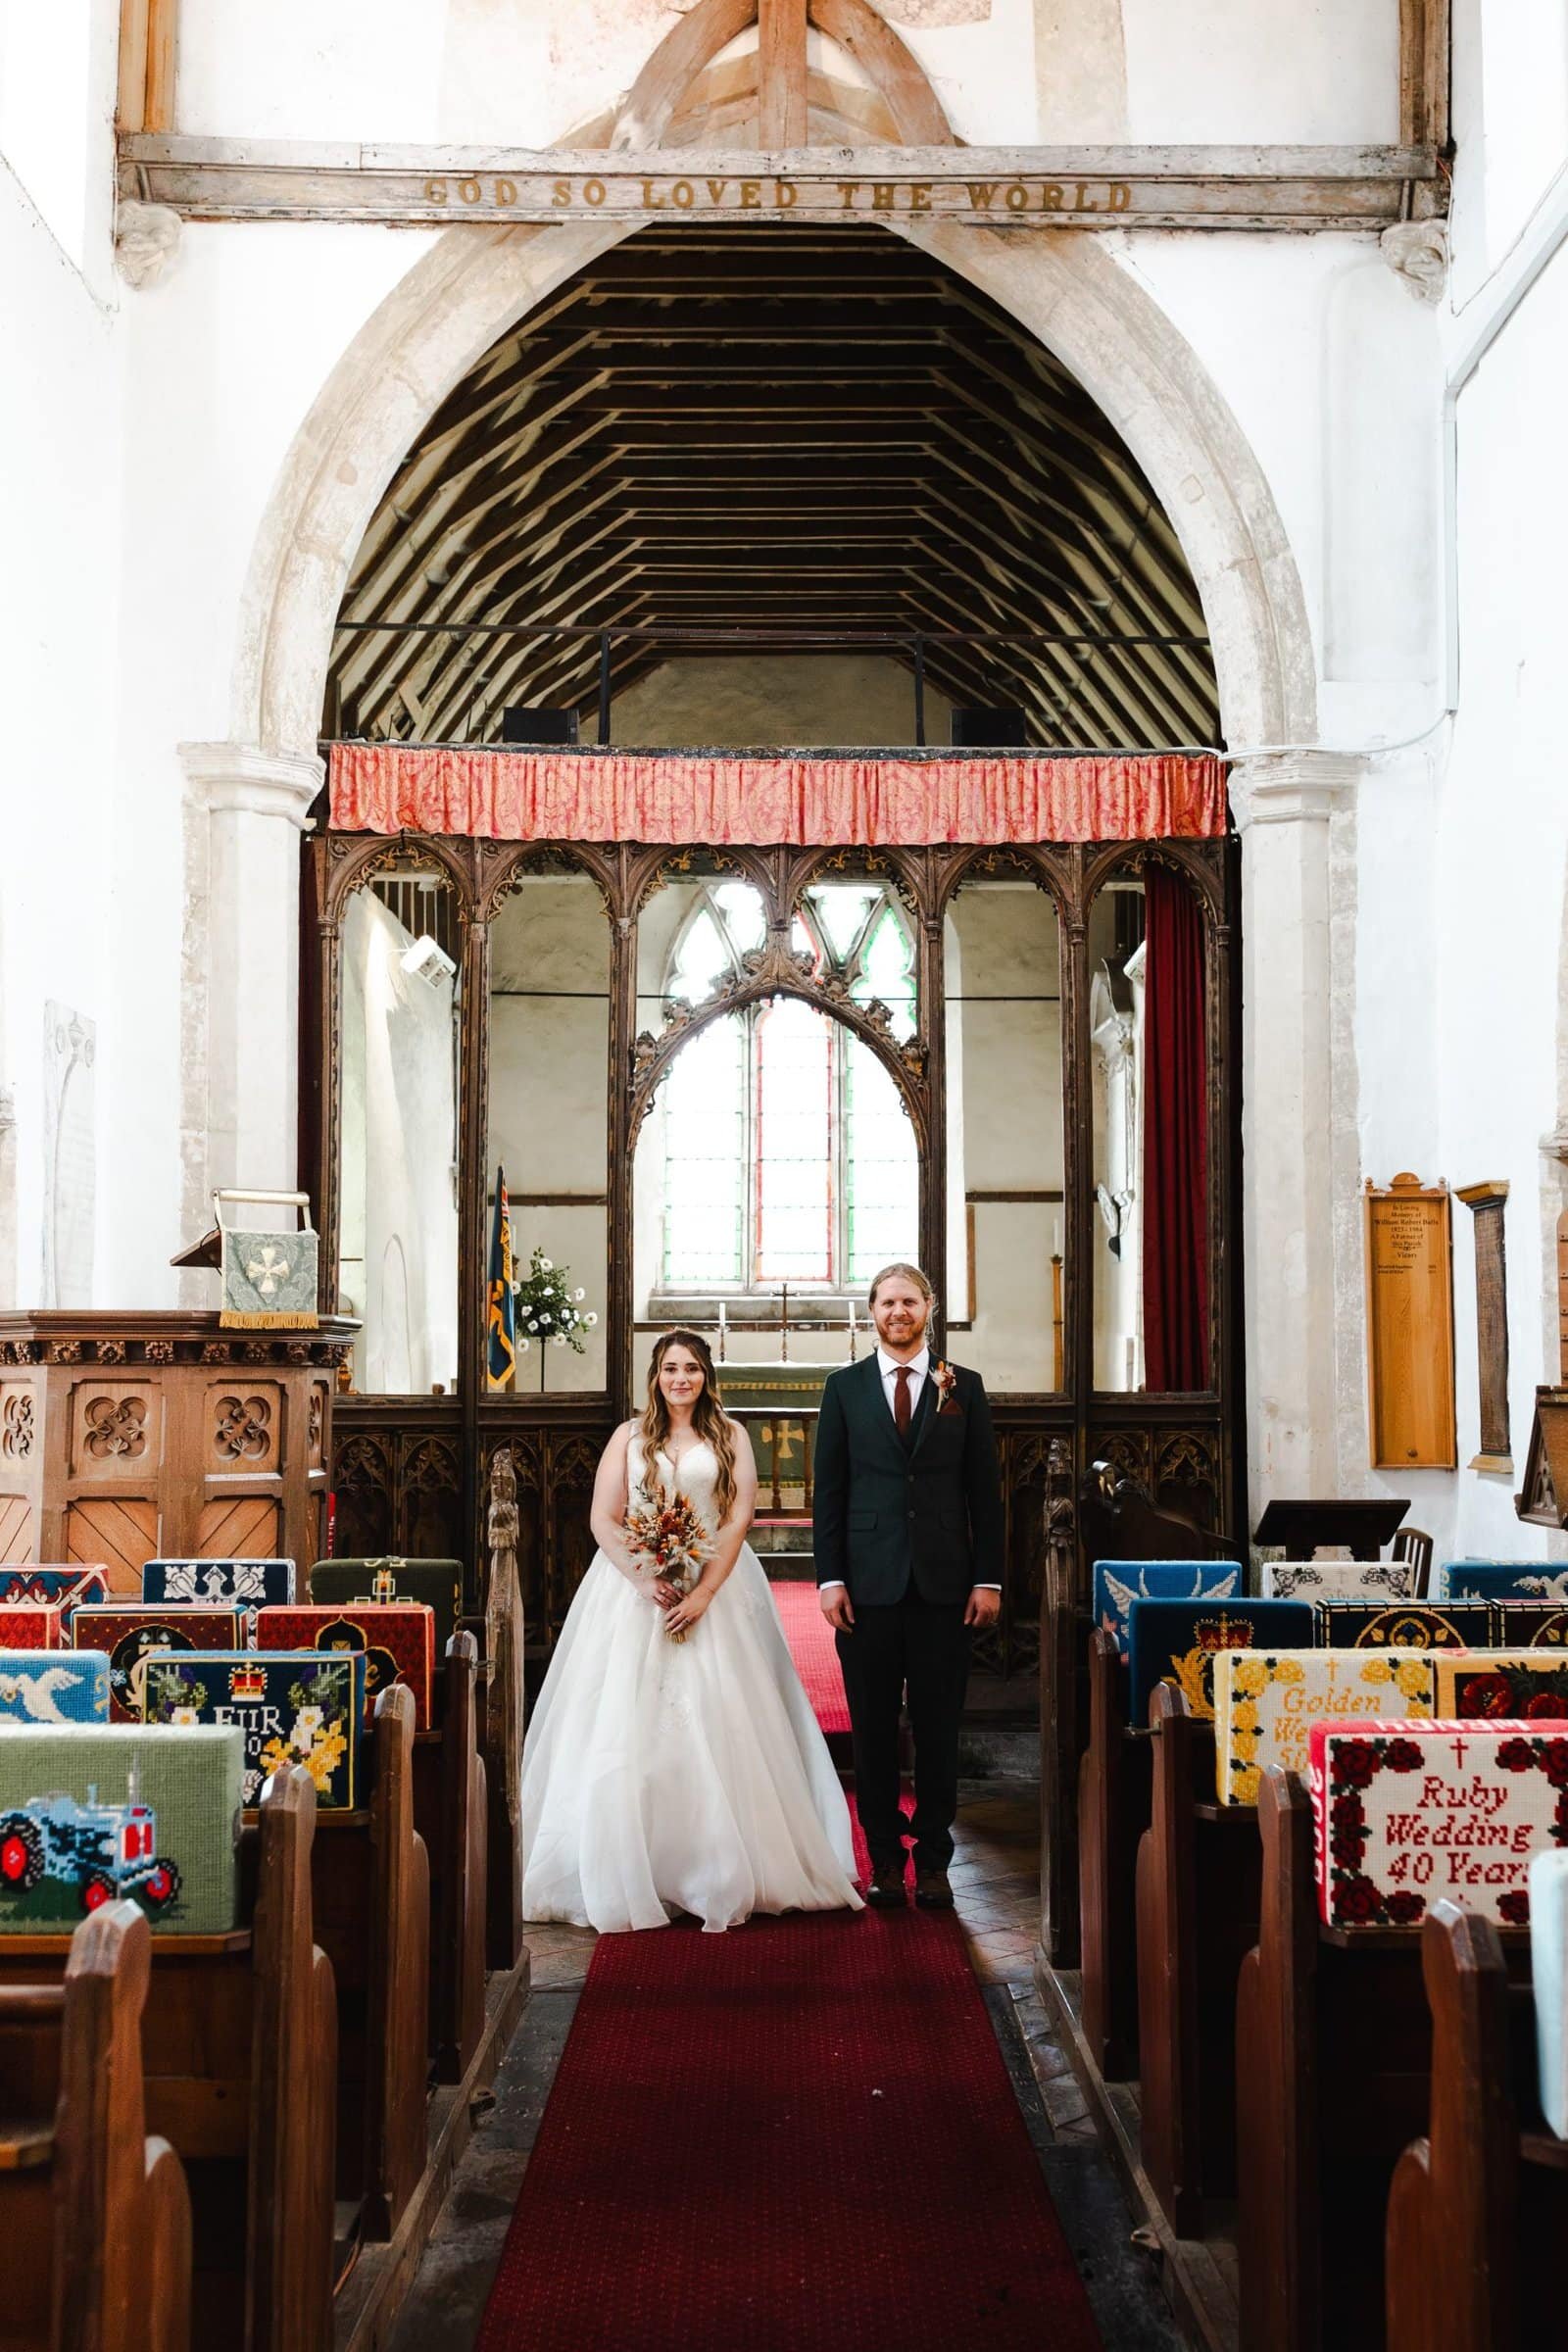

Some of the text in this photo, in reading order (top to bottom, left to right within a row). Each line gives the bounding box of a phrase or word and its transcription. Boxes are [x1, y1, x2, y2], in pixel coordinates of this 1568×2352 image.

[424, 178, 1131, 212] GOD SO LOVED THE WORLD
[1284, 1687, 1381, 1712] Golden
[1417, 1776, 1507, 1815] Ruby
[1387, 1814, 1534, 1852] Wedding
[1388, 1852, 1433, 1884] 40
